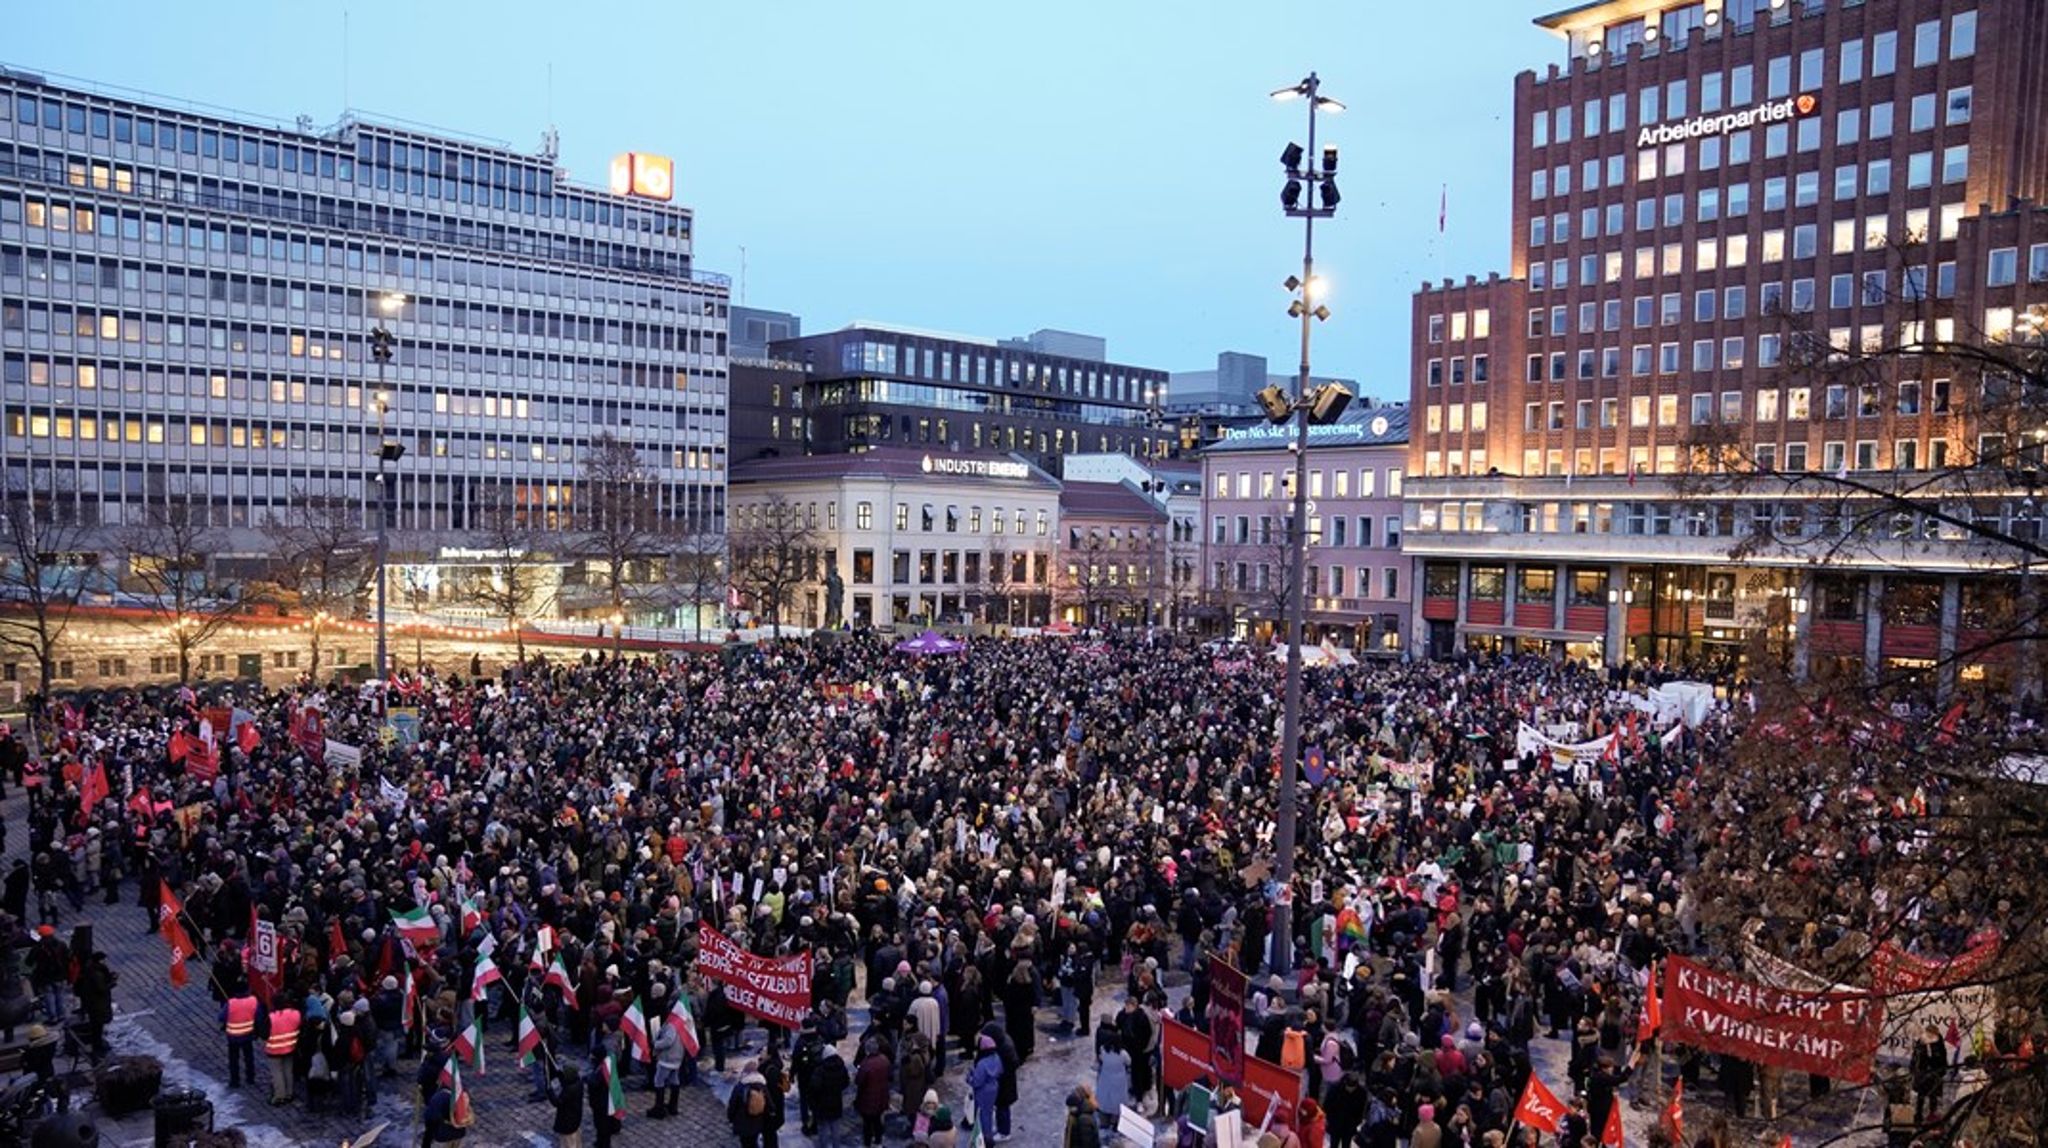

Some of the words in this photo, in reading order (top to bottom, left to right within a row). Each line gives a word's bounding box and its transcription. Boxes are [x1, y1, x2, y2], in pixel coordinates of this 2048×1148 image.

[1637, 98, 1794, 147] Arbeiderpartiet
[1226, 427, 1247, 440] Den
[259, 934, 271, 956] 6
[699, 948, 733, 975] BEDRE
[1842, 998, 1873, 1029] ER
[1684, 1005, 1844, 1060] KVINNEKAMP
